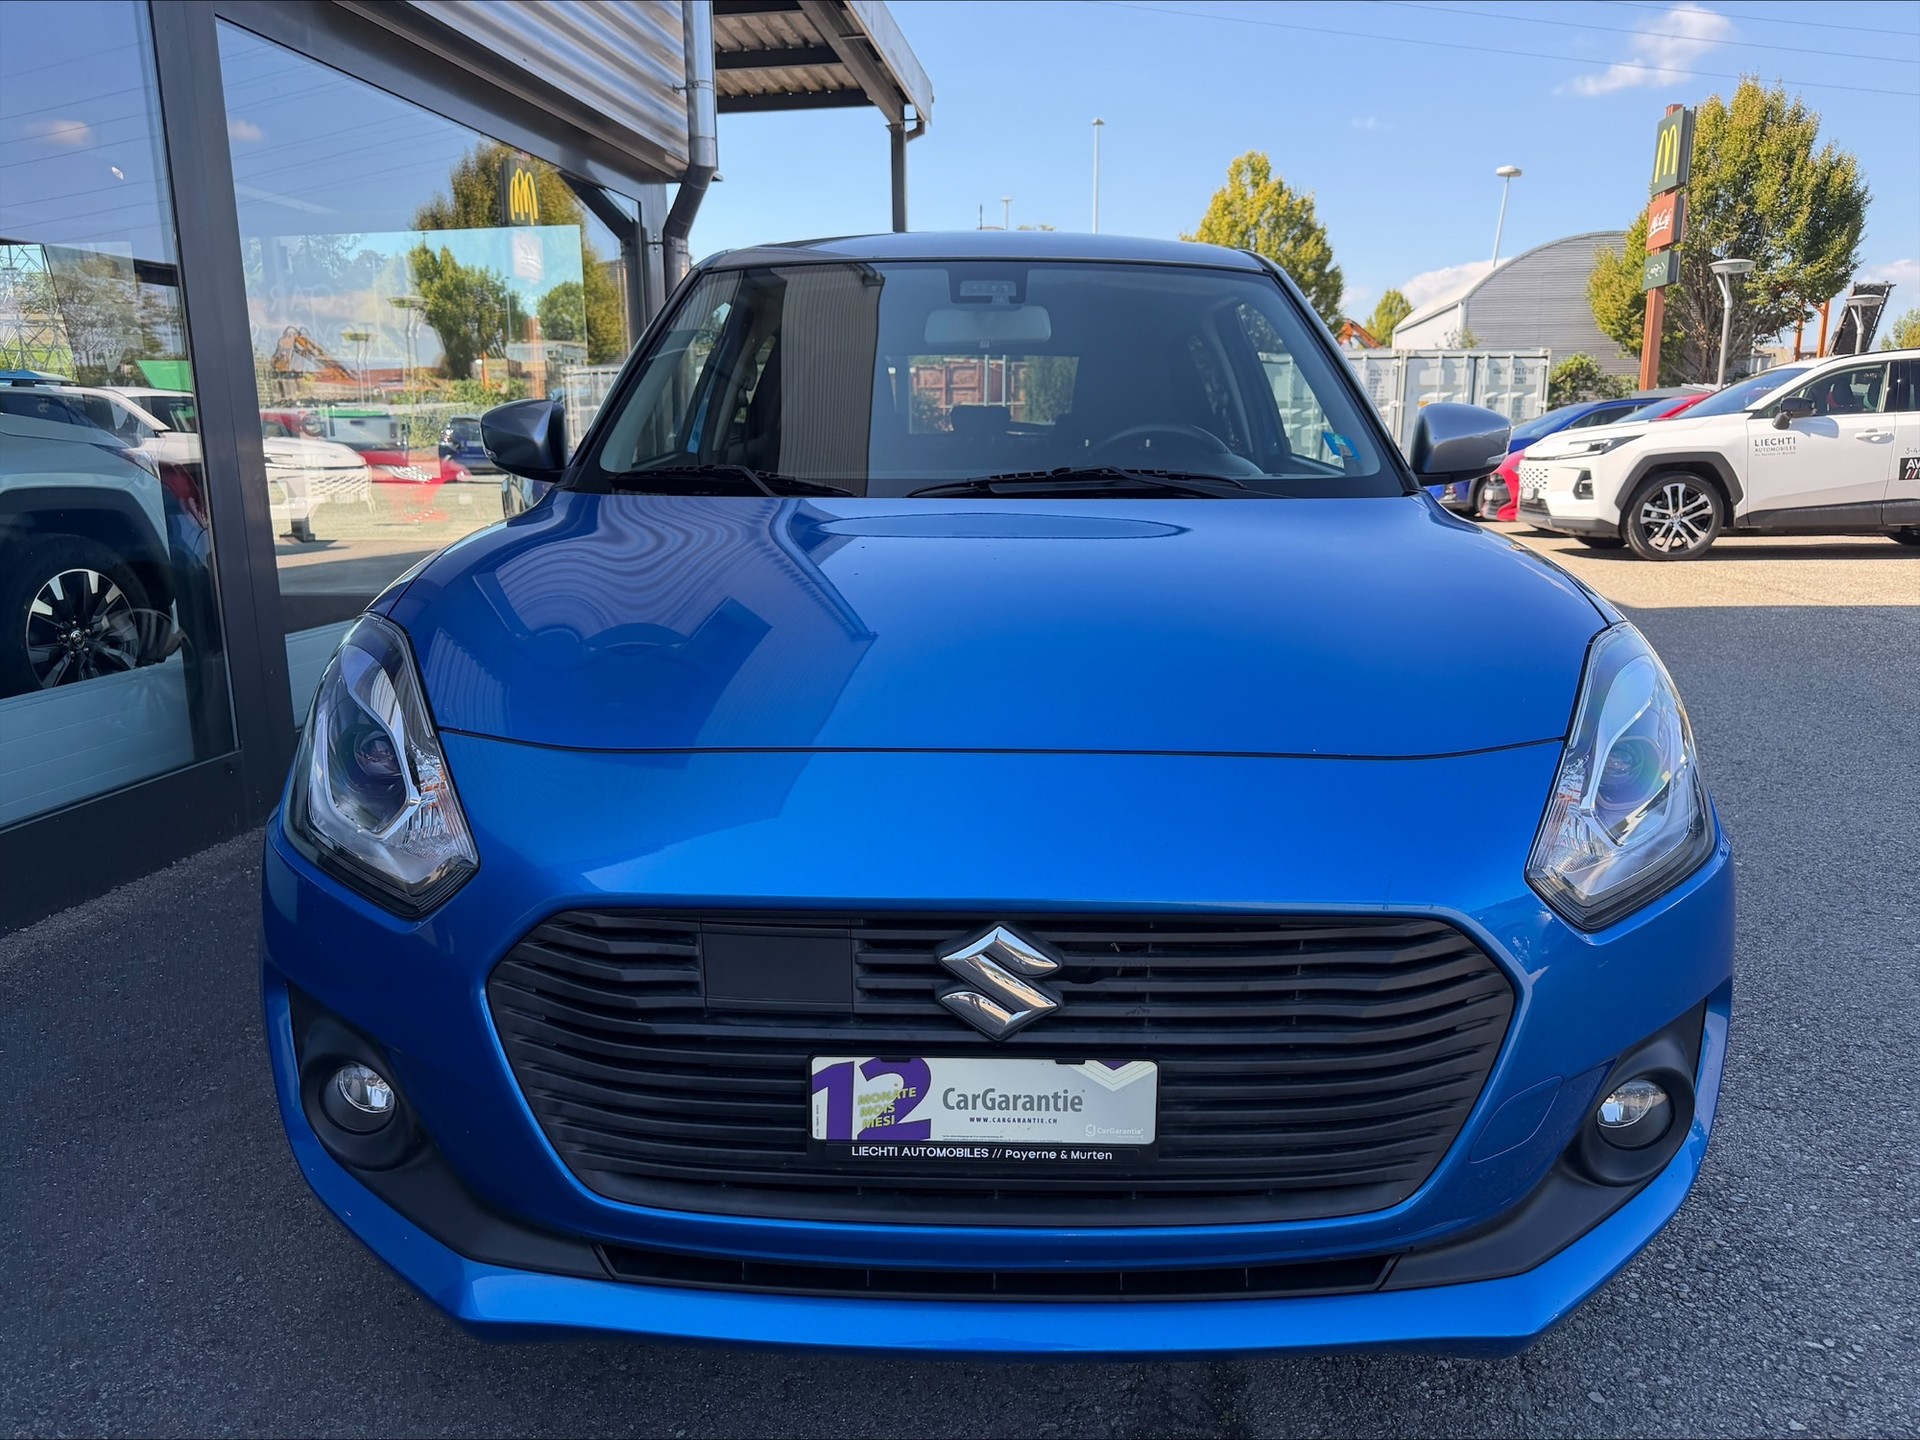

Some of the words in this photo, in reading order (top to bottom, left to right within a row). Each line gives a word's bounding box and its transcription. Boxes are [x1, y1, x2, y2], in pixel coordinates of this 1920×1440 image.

[1754, 437, 1796, 447] LIECHTI
[812, 1057, 931, 1139] 12
[857, 1087, 917, 1105] MONATE
[942, 1087, 1083, 1112] CarGarantie
[860, 1103, 895, 1117] MOIS
[863, 1115, 895, 1128] MESI
[969, 1116, 1058, 1124] WWW.CARGARANTIE.CH
[851, 1146, 898, 1157] LIECHTI
[901, 1147, 989, 1158] AUTOMOBILES
[1005, 1149, 1058, 1161] Payerne
[1060, 1150, 1068, 1159] &
[1070, 1150, 1113, 1160] Murten
